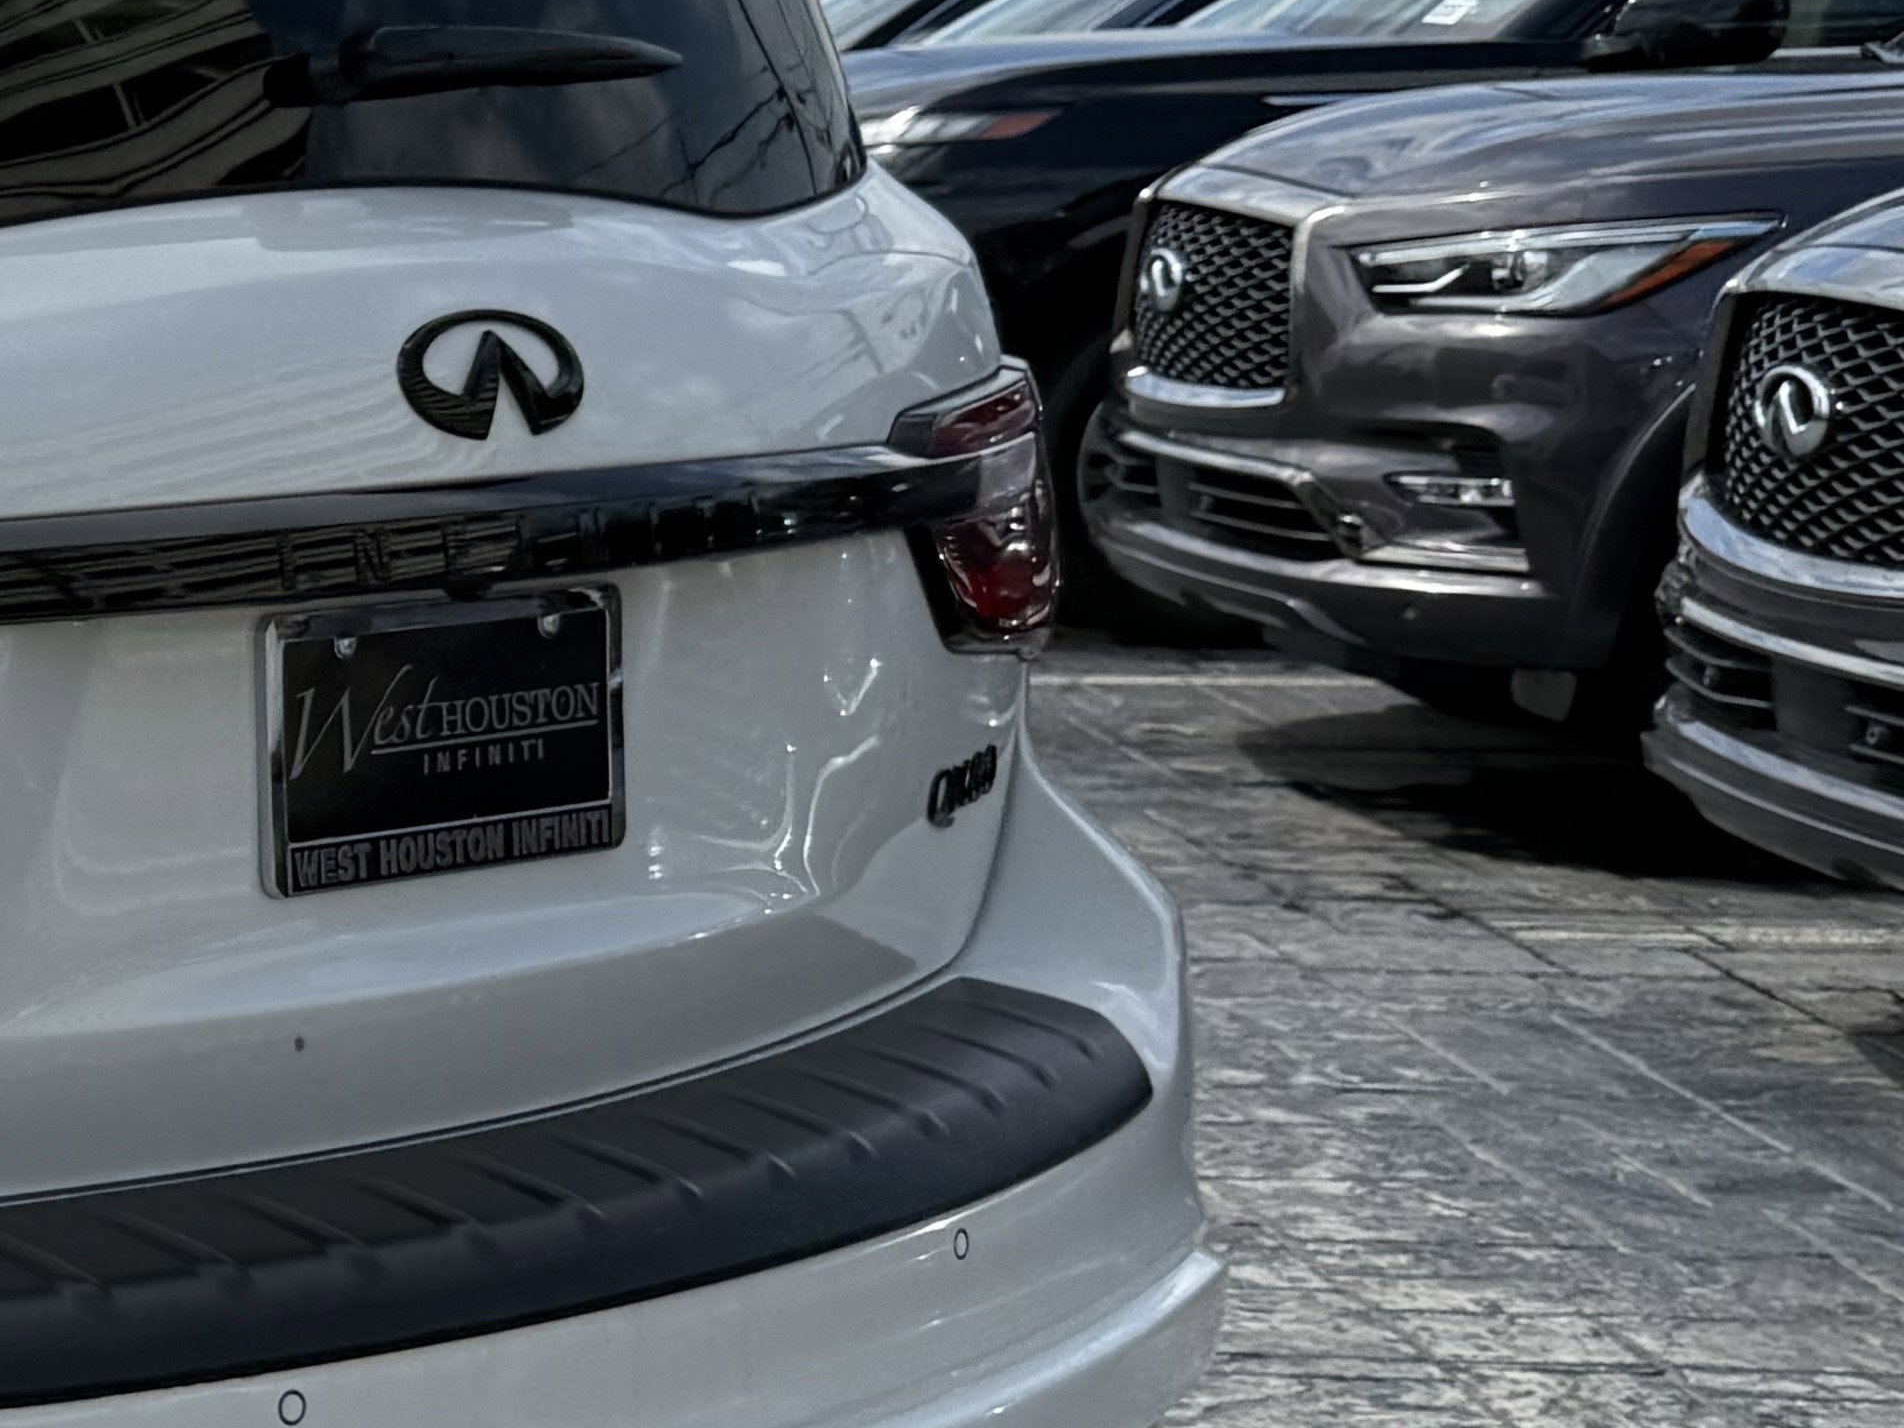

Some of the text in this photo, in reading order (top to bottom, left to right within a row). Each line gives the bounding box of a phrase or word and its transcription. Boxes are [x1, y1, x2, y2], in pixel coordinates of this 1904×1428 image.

[289, 664, 600, 780] West HOUSTON
[423, 738, 545, 775] INFINITI
[294, 809, 610, 888] WEST HOUSTON INFINITI
